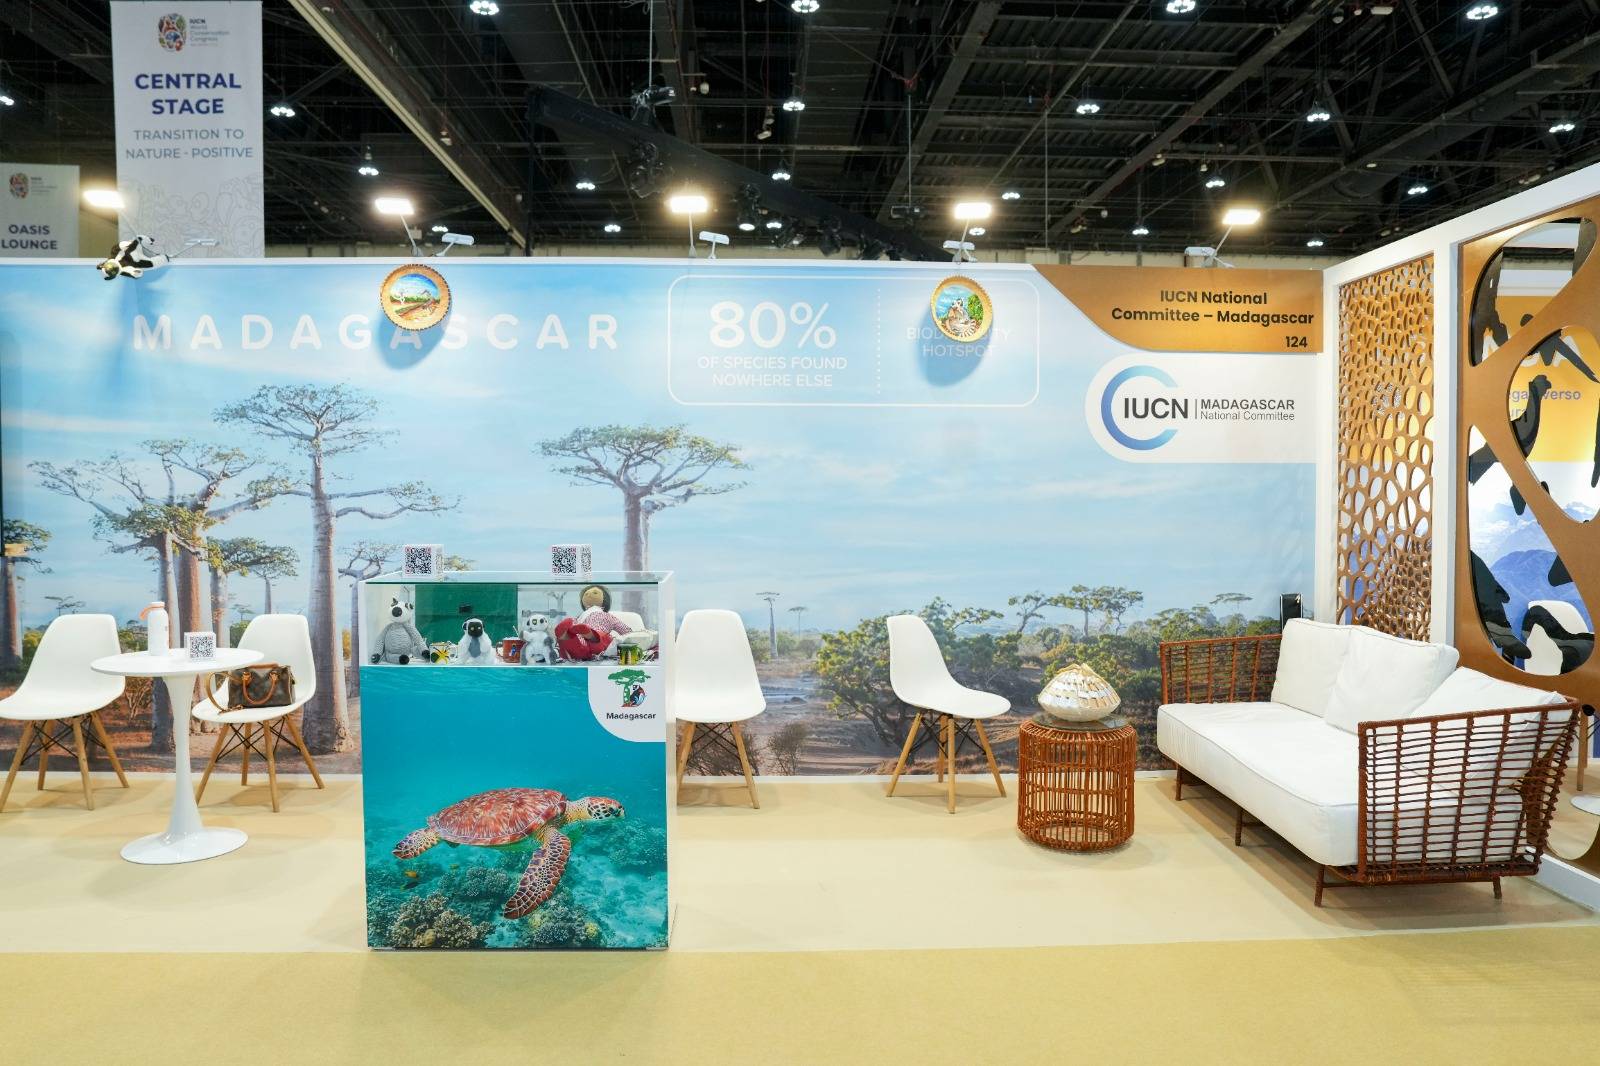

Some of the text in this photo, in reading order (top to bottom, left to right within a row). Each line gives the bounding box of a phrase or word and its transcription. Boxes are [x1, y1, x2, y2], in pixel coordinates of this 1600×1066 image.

[135, 73, 241, 90] CENTRAL
[151, 98, 224, 115] STAGE
[133, 128, 244, 140] TRANSITION TO
[8, 224, 50, 236] OASIS
[1, 239, 58, 250] LOUNGE
[1160, 290, 1267, 305] IUCN National
[1111, 307, 1200, 322] Committee
[1217, 310, 1314, 327] Madagascar
[709, 300, 837, 349] 80%
[1285, 335, 1308, 348] 124
[922, 344, 997, 357] HOTSPOT
[697, 356, 848, 370] OF SPECIES FOUND
[712, 373, 833, 387] NOWHERE ELSE
[1123, 397, 1189, 420] IUCN
[1200, 399, 1295, 410] MADAGASCAR
[1200, 410, 1295, 421] National Committee
[606, 712, 656, 721] Madagascar
